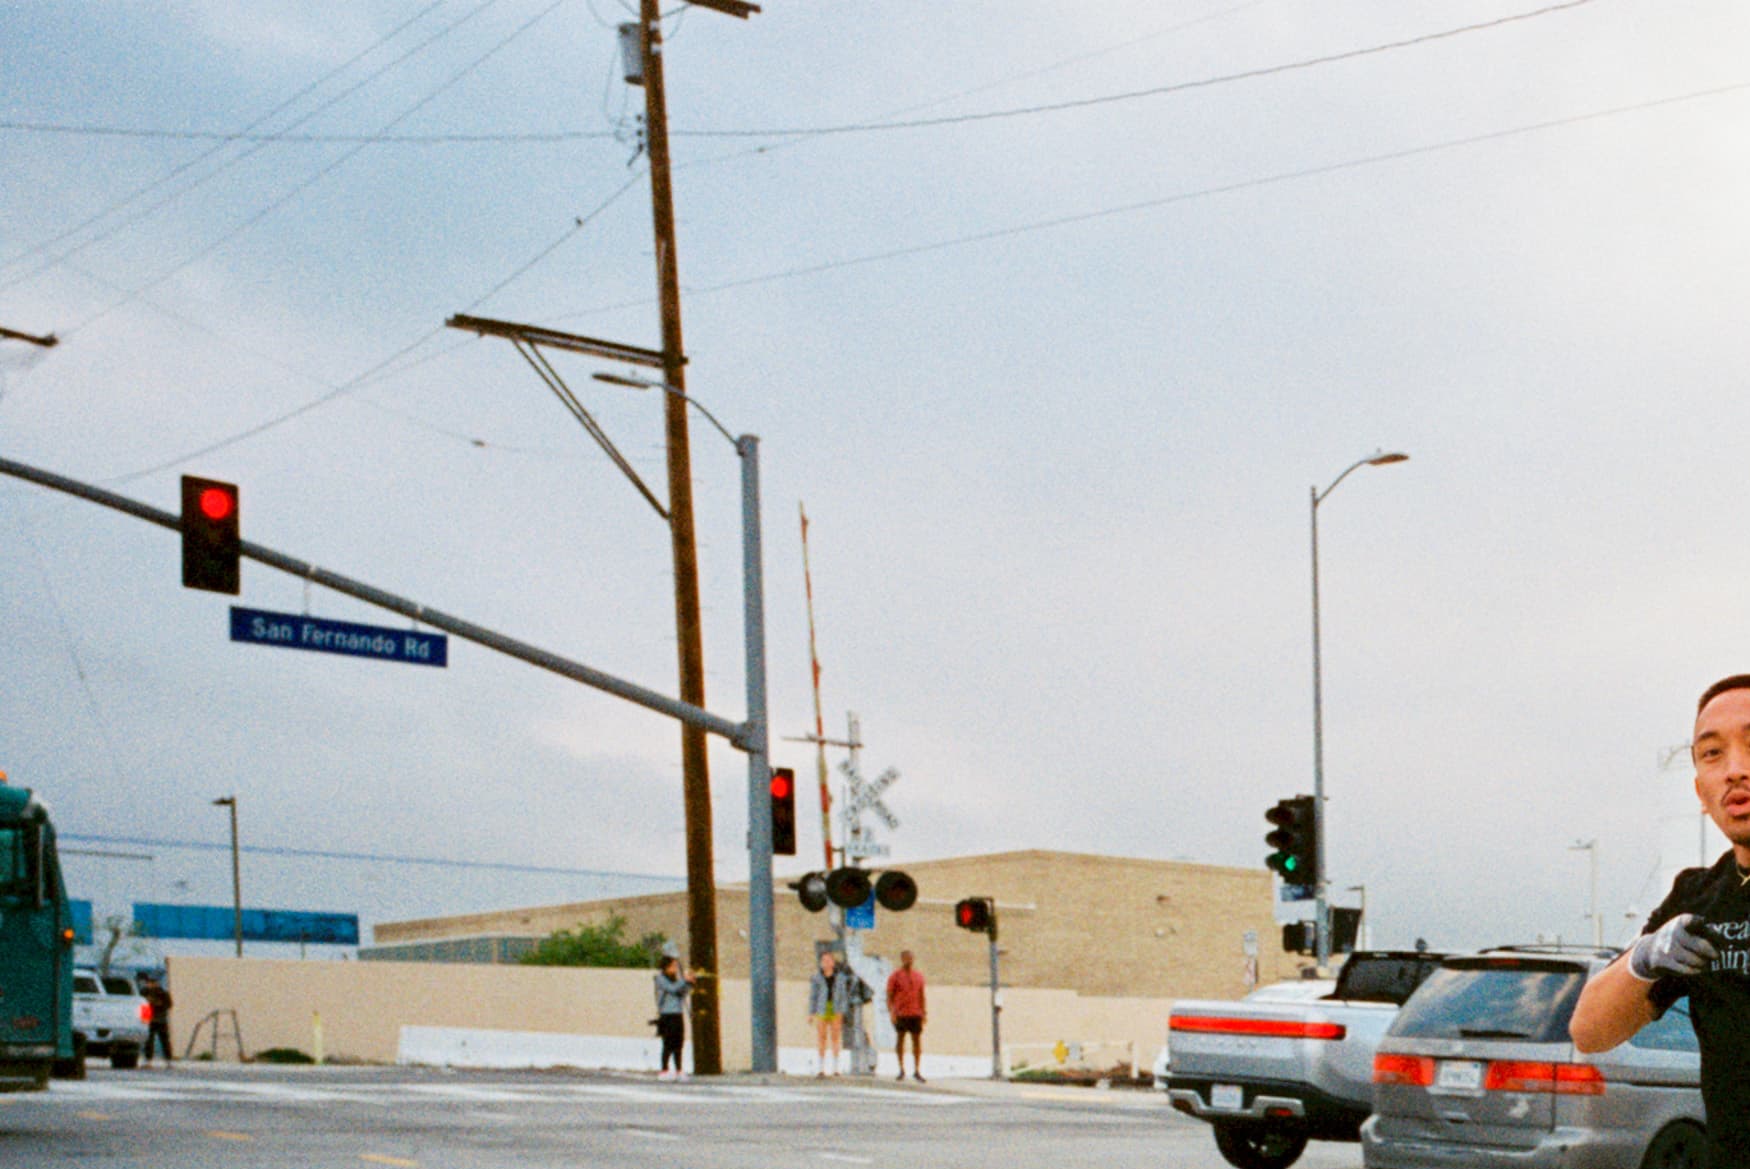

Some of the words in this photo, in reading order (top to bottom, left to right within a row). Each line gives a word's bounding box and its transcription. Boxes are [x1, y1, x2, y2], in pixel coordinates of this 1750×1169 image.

[251, 617, 293, 641] San
[301, 623, 396, 655] Fernando
[404, 638, 431, 659] Rd
